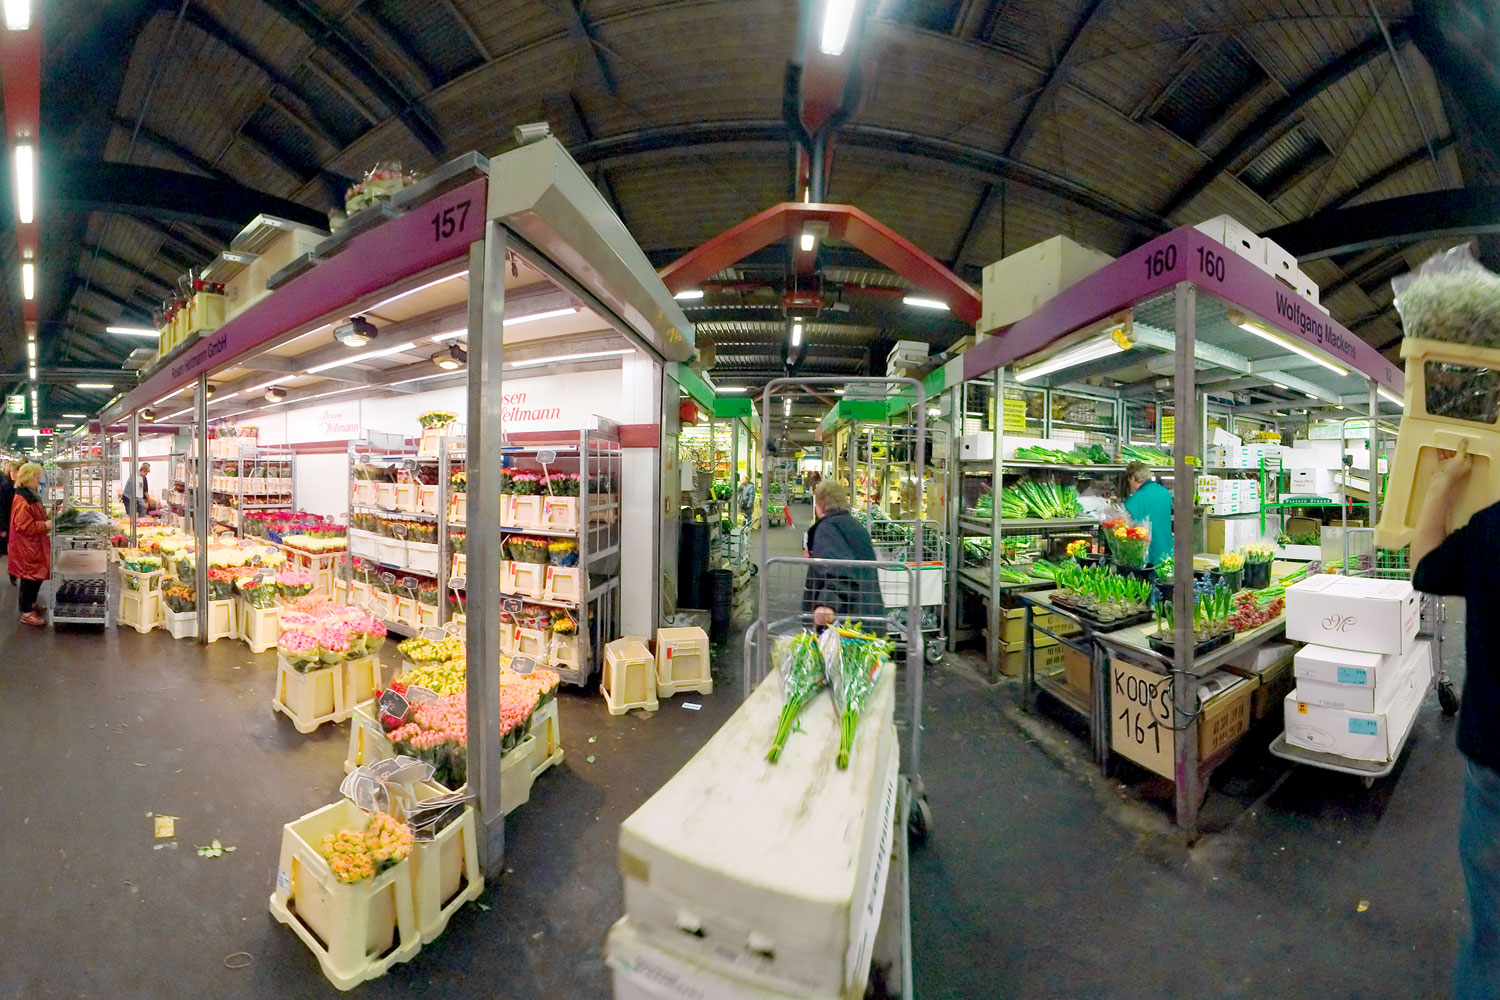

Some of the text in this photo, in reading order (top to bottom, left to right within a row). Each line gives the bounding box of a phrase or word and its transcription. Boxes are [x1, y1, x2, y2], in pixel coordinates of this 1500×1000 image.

[431, 200, 472, 242] 157
[1145, 244, 1177, 280] 160
[1197, 246, 1225, 283] 160
[1276, 291, 1357, 359] Wolfgang Mackens
[207, 332, 227, 358] GmbH
[501, 392, 527, 406] sen
[501, 407, 561, 422] eitmann
[1114, 668, 1170, 719] KOOPS
[1119, 708, 1160, 754] 161
